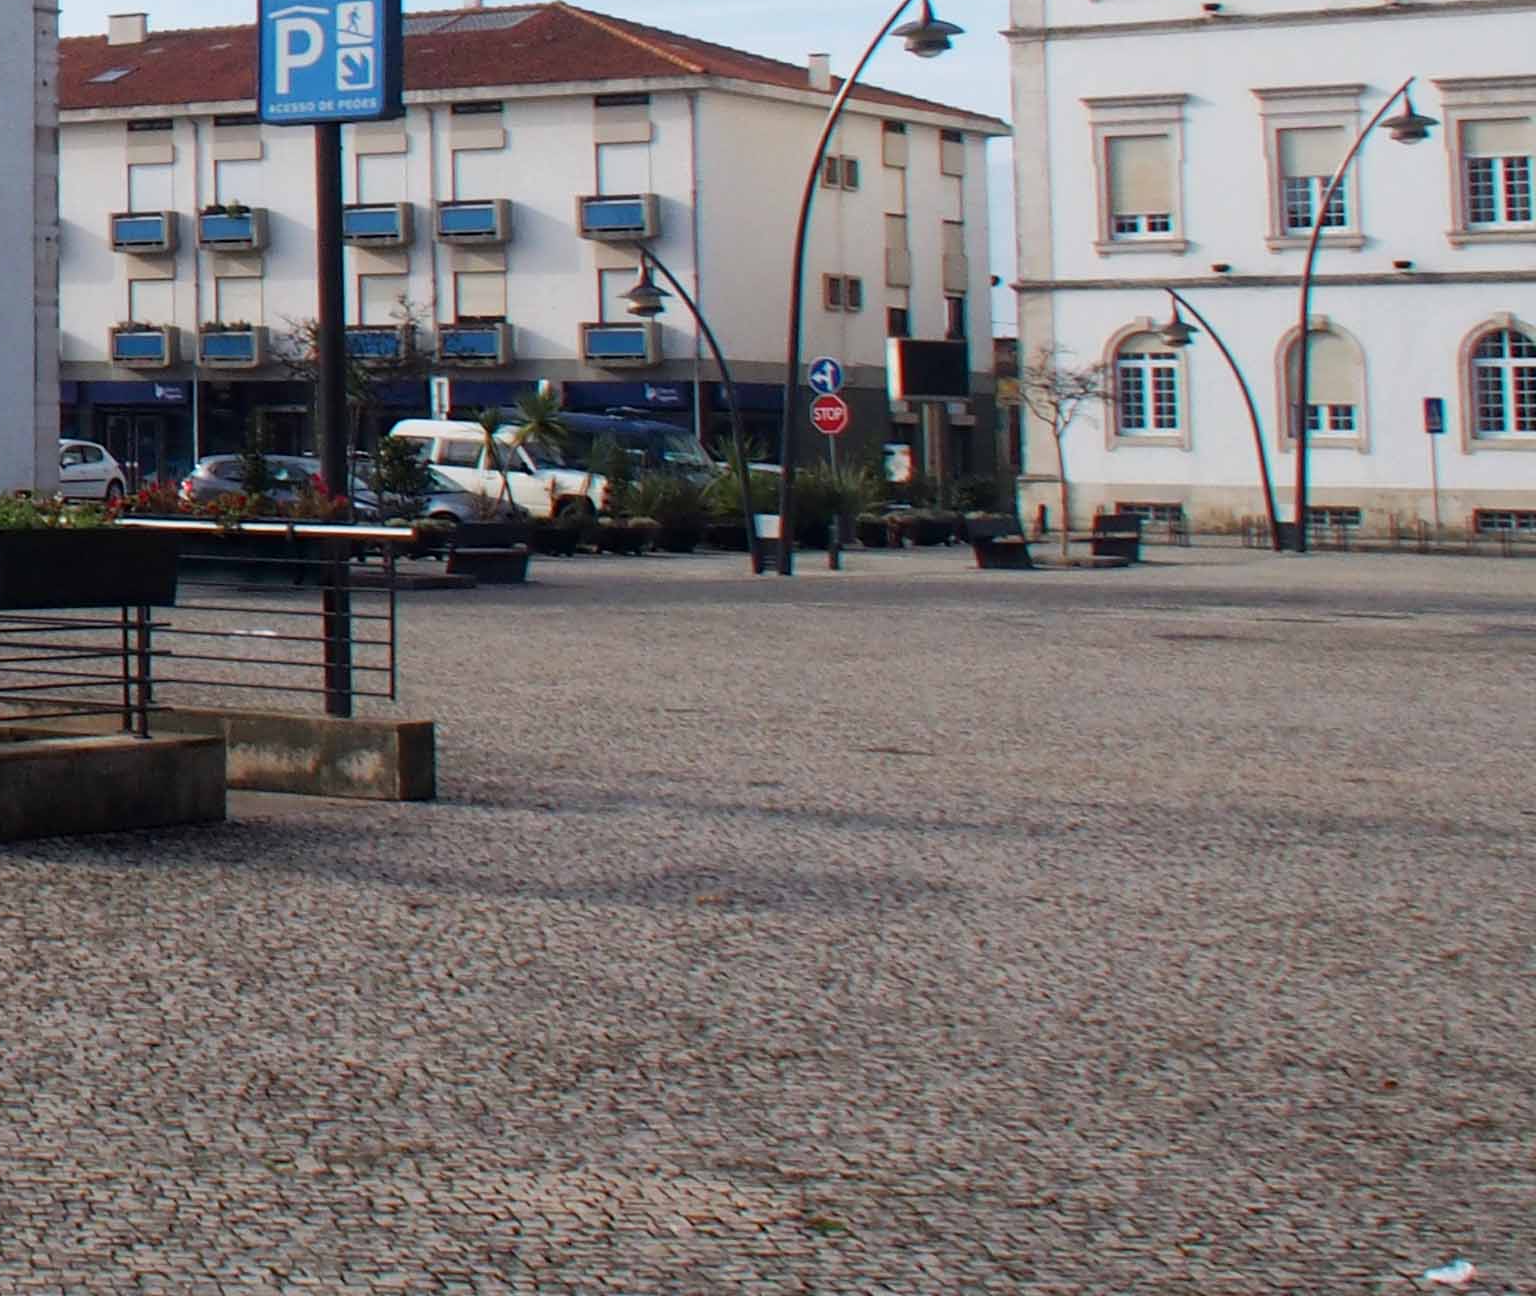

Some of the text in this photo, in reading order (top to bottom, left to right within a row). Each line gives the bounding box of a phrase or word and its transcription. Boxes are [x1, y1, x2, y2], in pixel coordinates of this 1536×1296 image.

[276, 17, 324, 95] P
[269, 101, 316, 113] ACESSO
[318, 100, 335, 112] DE
[815, 407, 842, 421] STOP
